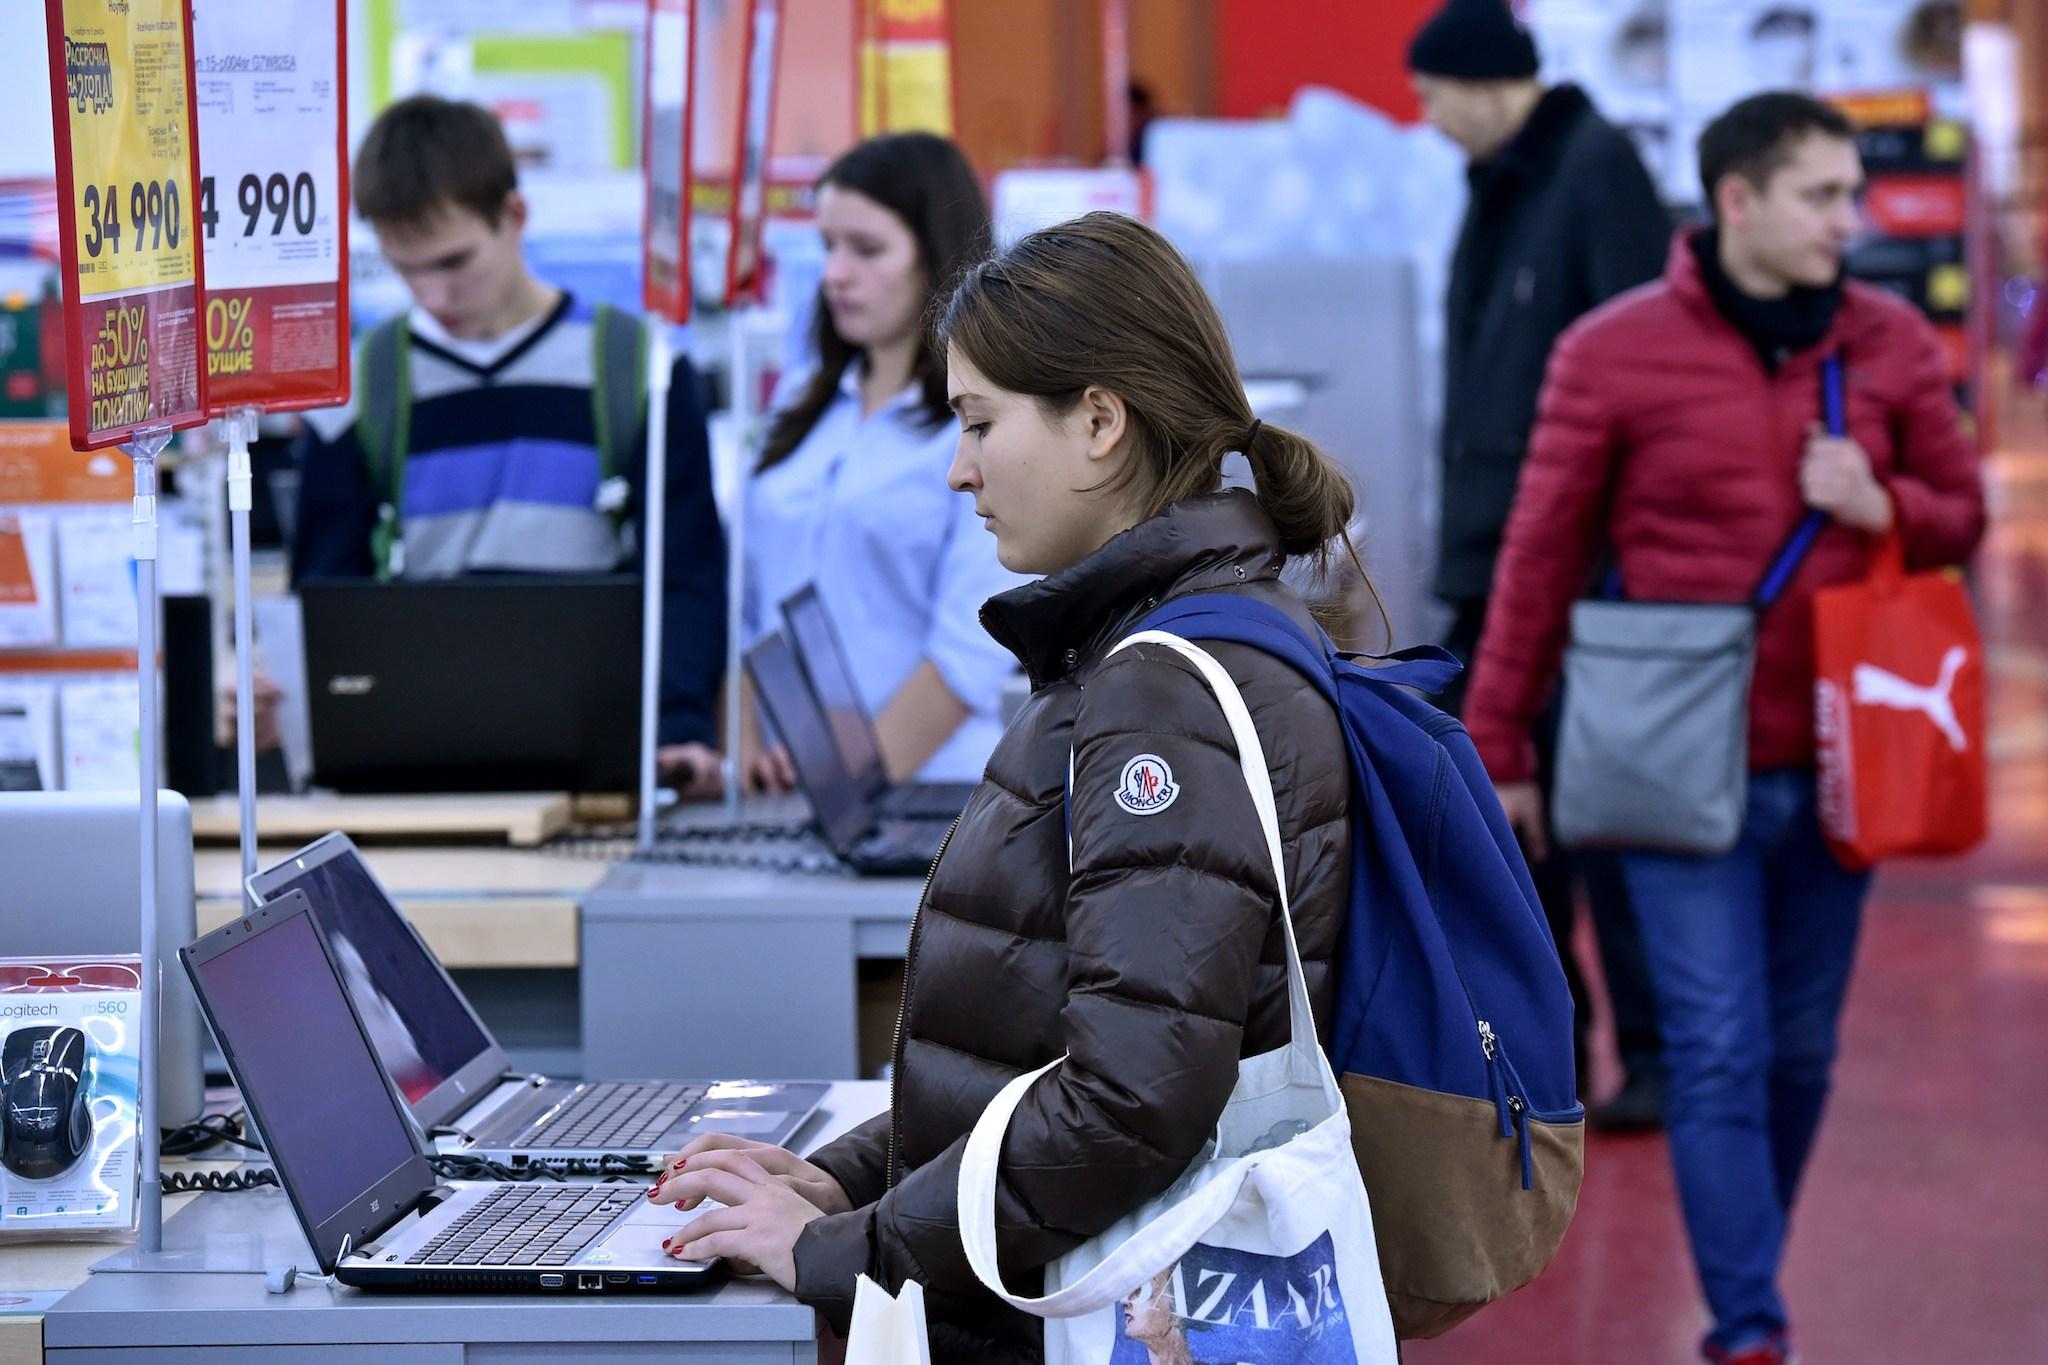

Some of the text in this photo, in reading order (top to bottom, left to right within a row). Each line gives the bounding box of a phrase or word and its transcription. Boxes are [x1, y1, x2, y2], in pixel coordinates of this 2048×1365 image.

[84, 179, 180, 257] 34 990
[238, 172, 316, 237] 990
[91, 343, 106, 371] ДО
[99, 305, 148, 368] -50%
[92, 363, 149, 397] НА БУДУЩИЕ
[92, 391, 149, 431] ПОКУПКИ
[1123, 788, 1170, 807] MONCLER
[83, 1001, 127, 1014] m560
